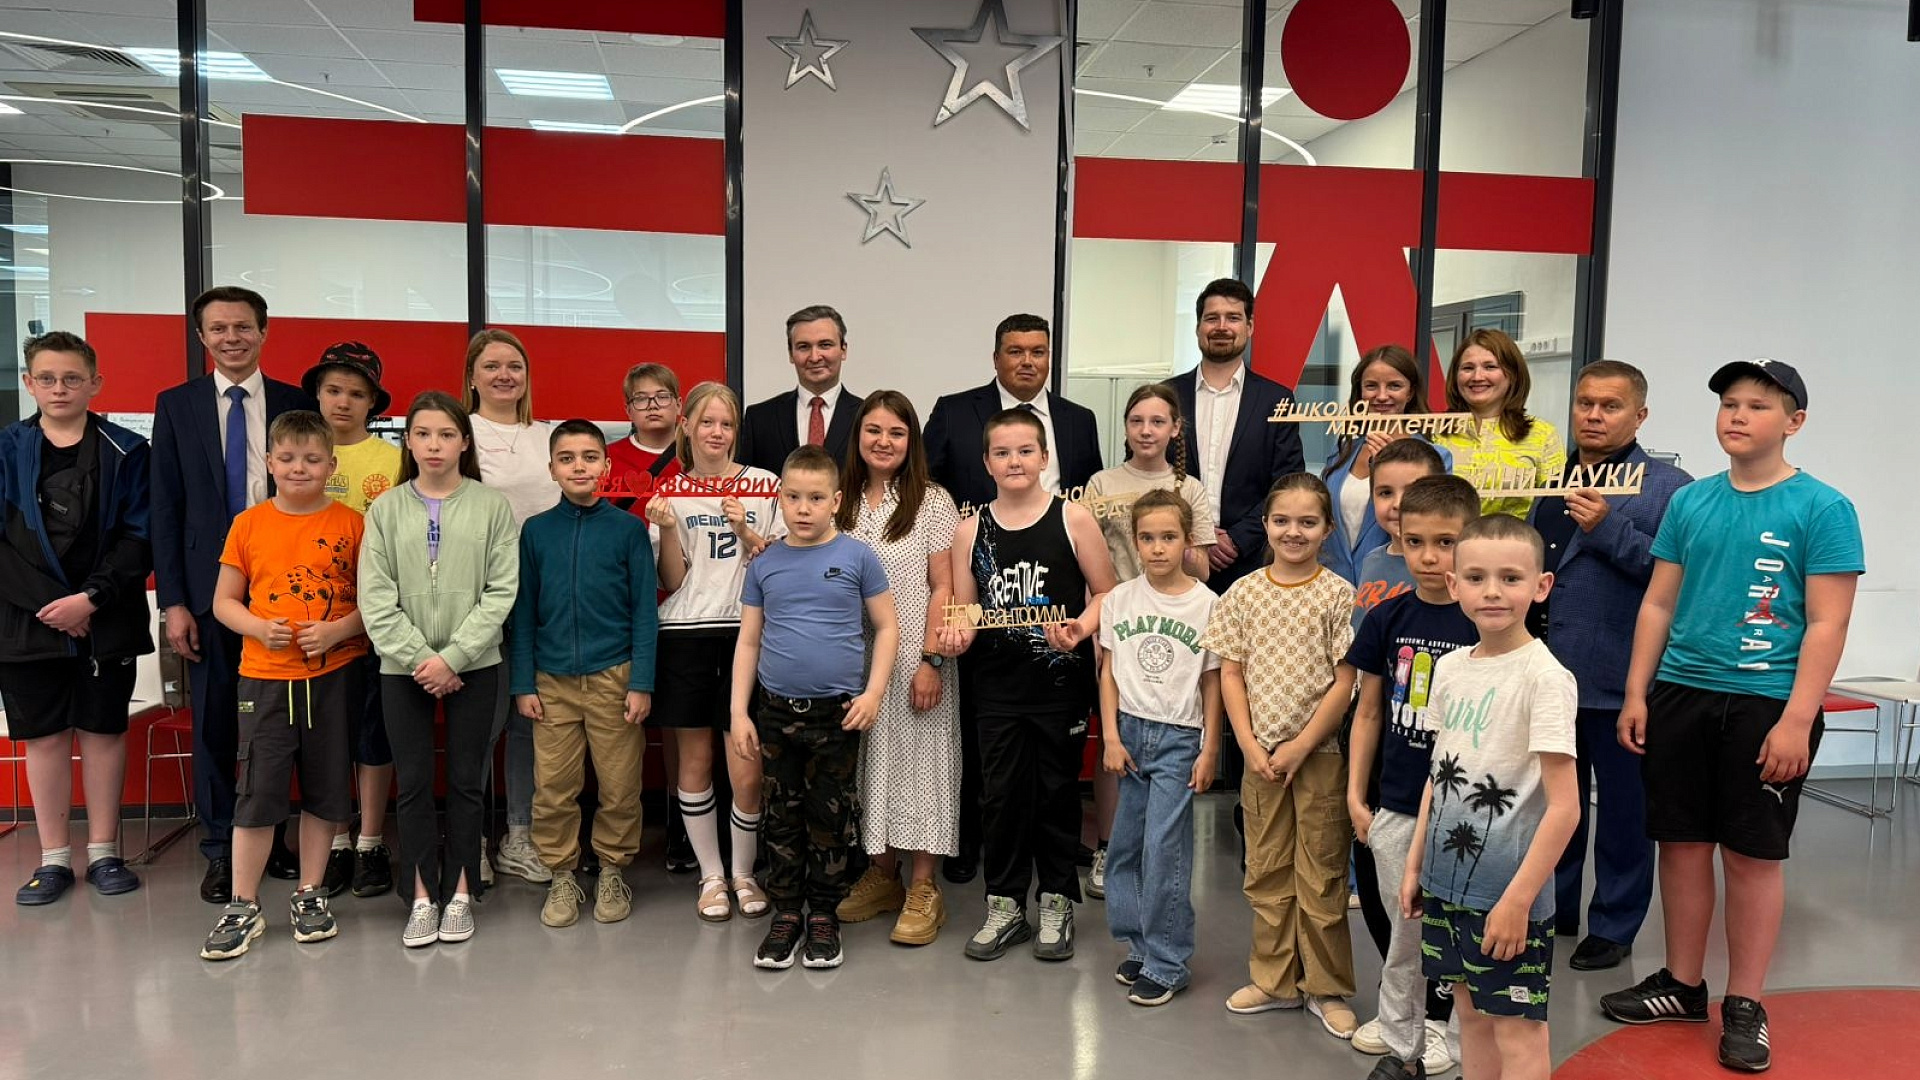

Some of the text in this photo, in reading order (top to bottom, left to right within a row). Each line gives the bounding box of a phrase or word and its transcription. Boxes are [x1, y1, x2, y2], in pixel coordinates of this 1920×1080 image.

[1544, 461, 1646, 491] НАУКИ
[686, 511, 757, 530] MEMPS
[708, 531, 738, 560] 12
[988, 560, 1049, 608] CREATIVE
[1113, 615, 1158, 642] PLAY
[1391, 700, 1429, 731] YOR
[1444, 686, 1496, 749] urf
